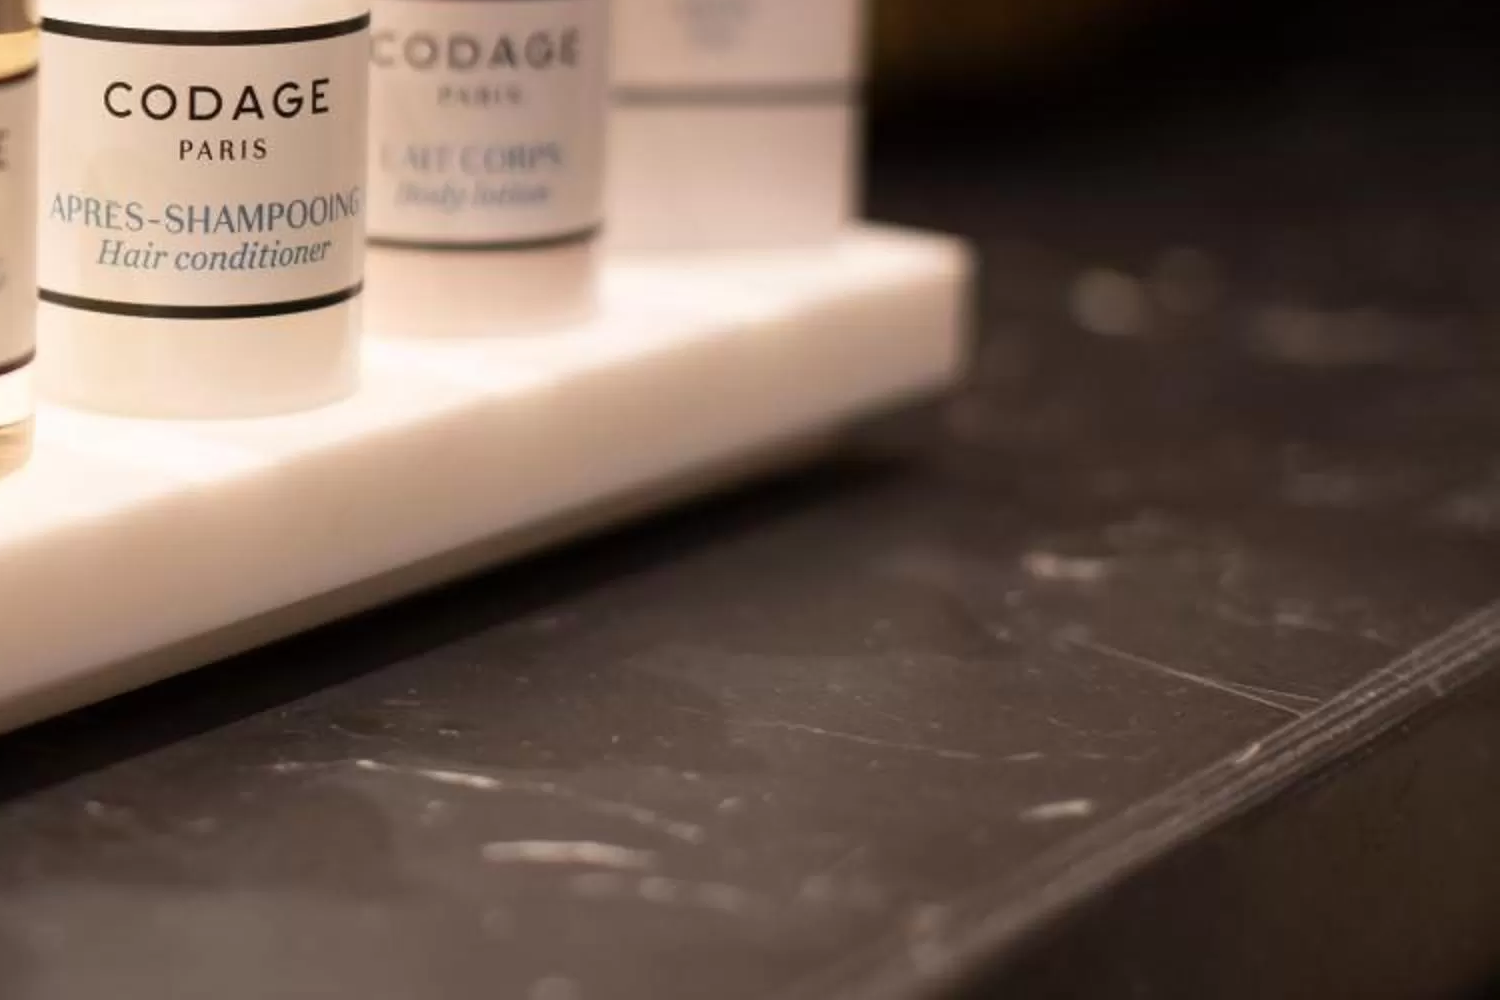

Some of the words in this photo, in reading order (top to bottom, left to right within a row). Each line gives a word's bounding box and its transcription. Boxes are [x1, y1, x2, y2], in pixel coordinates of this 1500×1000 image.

[370, 26, 580, 71] CODAGE
[103, 77, 330, 121] CODAGE
[179, 138, 268, 161] PARIS
[49, 184, 360, 234] APRES-SHAMPOOING
[96, 239, 168, 270] Hair
[174, 239, 332, 272] conditioner
